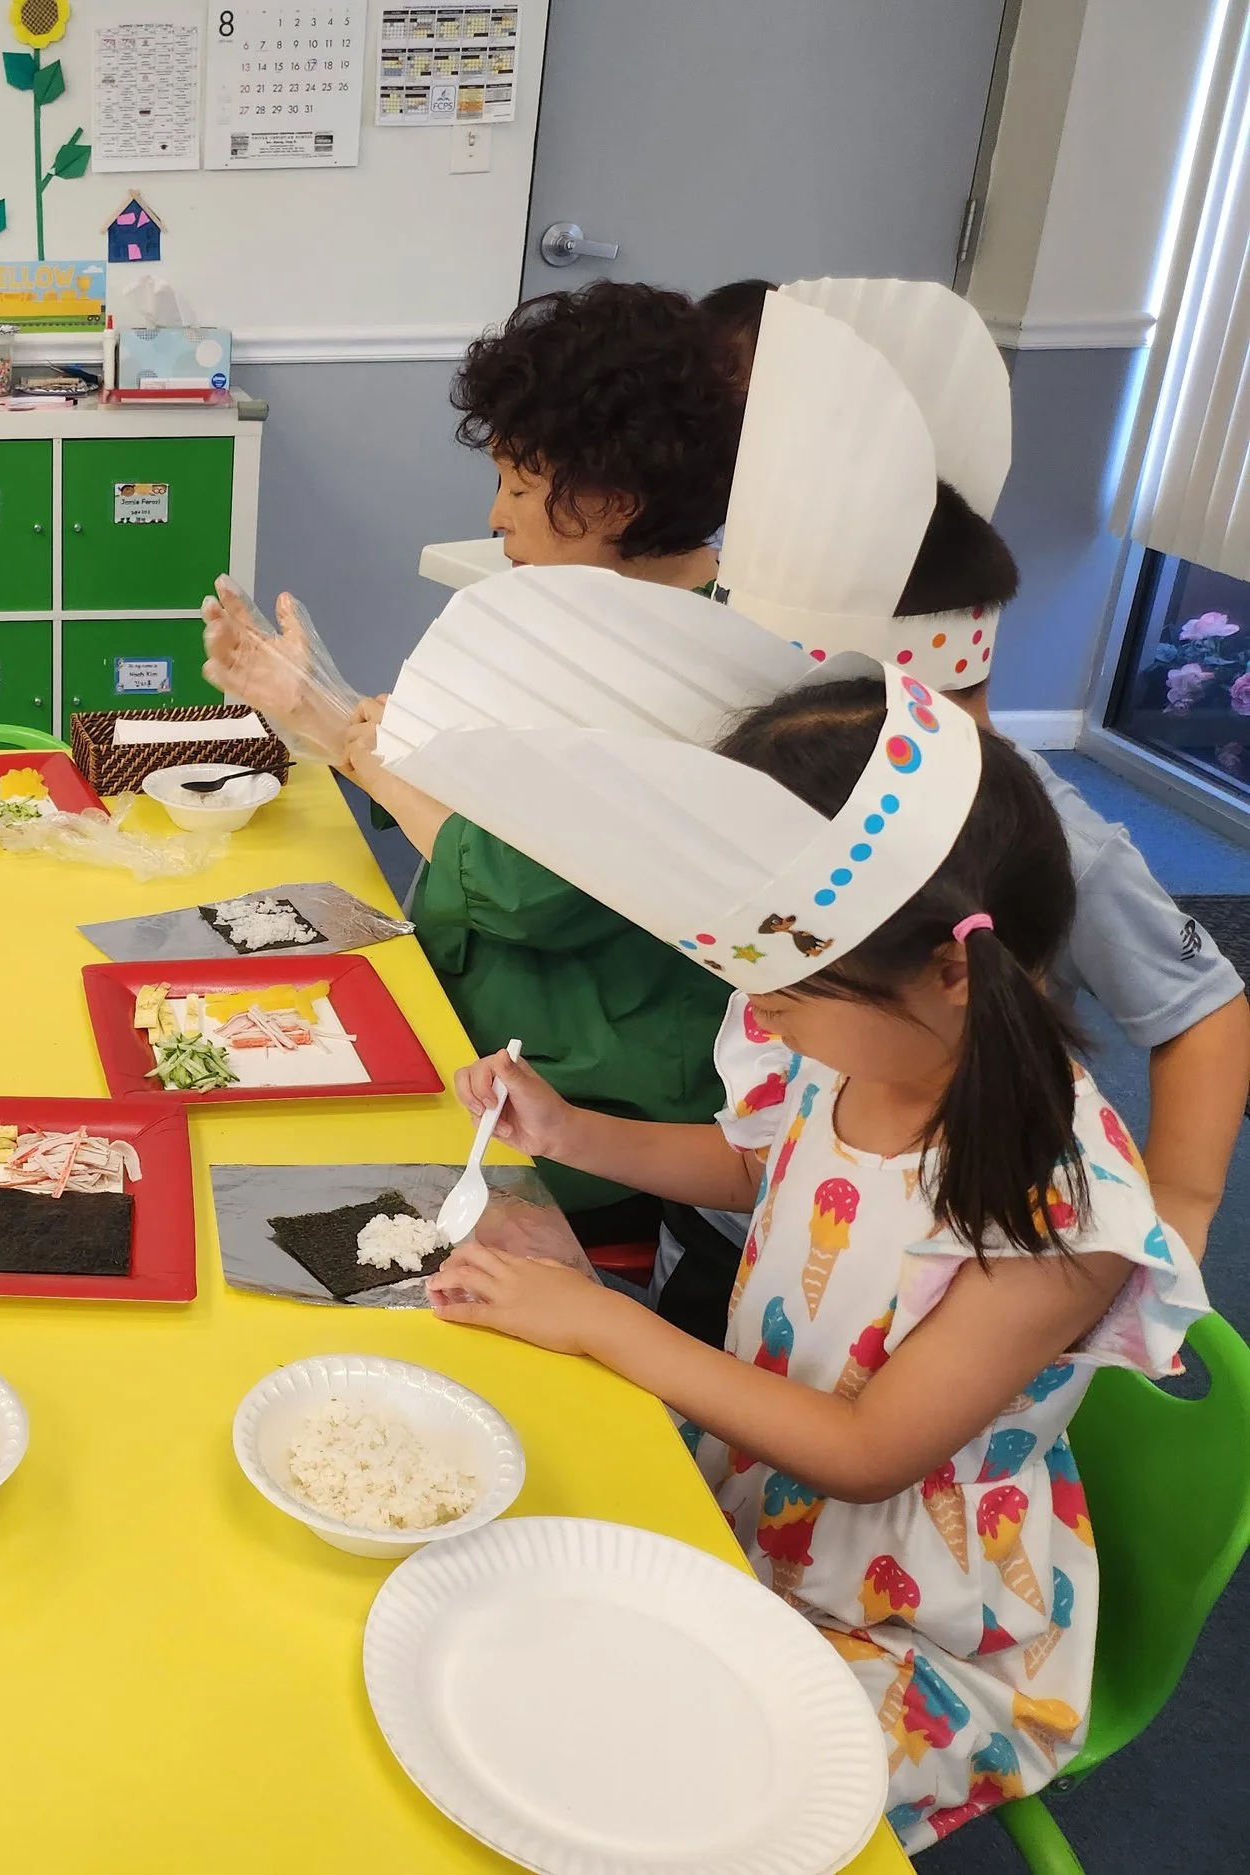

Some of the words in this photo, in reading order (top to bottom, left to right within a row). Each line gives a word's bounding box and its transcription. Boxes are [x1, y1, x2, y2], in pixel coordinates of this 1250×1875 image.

[219, 10, 234, 37] 8
[279, 18, 282, 27] 1
[295, 18, 300, 27] 2
[311, 18, 316, 27] 3
[327, 18, 333, 26] 4
[344, 17, 350, 26] 5
[243, 42, 249, 50] 6
[260, 41, 265, 49] 7
[277, 41, 282, 49] 8
[293, 40, 299, 48] 9
[308, 40, 318, 48] 10
[325, 39, 332, 48] 11
[342, 39, 351, 47] 12
[241, 63, 250, 72] 13
[258, 63, 267, 71] 14
[274, 62, 283, 71] 15
[291, 62, 300, 71] 16
[307, 61, 317, 71] 17
[324, 61, 333, 70] 18
[341, 61, 350, 69] 19
[240, 85, 250, 93] 20
[257, 84, 265, 93] 21
[273, 84, 283, 93] 22
[289, 84, 299, 92] 23
[305, 83, 316, 92] 24
[322, 83, 332, 91] 25
[339, 83, 349, 91] 26
[240, 106, 249, 115] 27
[256, 106, 266, 114] 28
[272, 106, 282, 114] 29
[288, 105, 298, 113] 30
[304, 105, 313, 113] 31
[433, 102, 453, 110] FCPS
